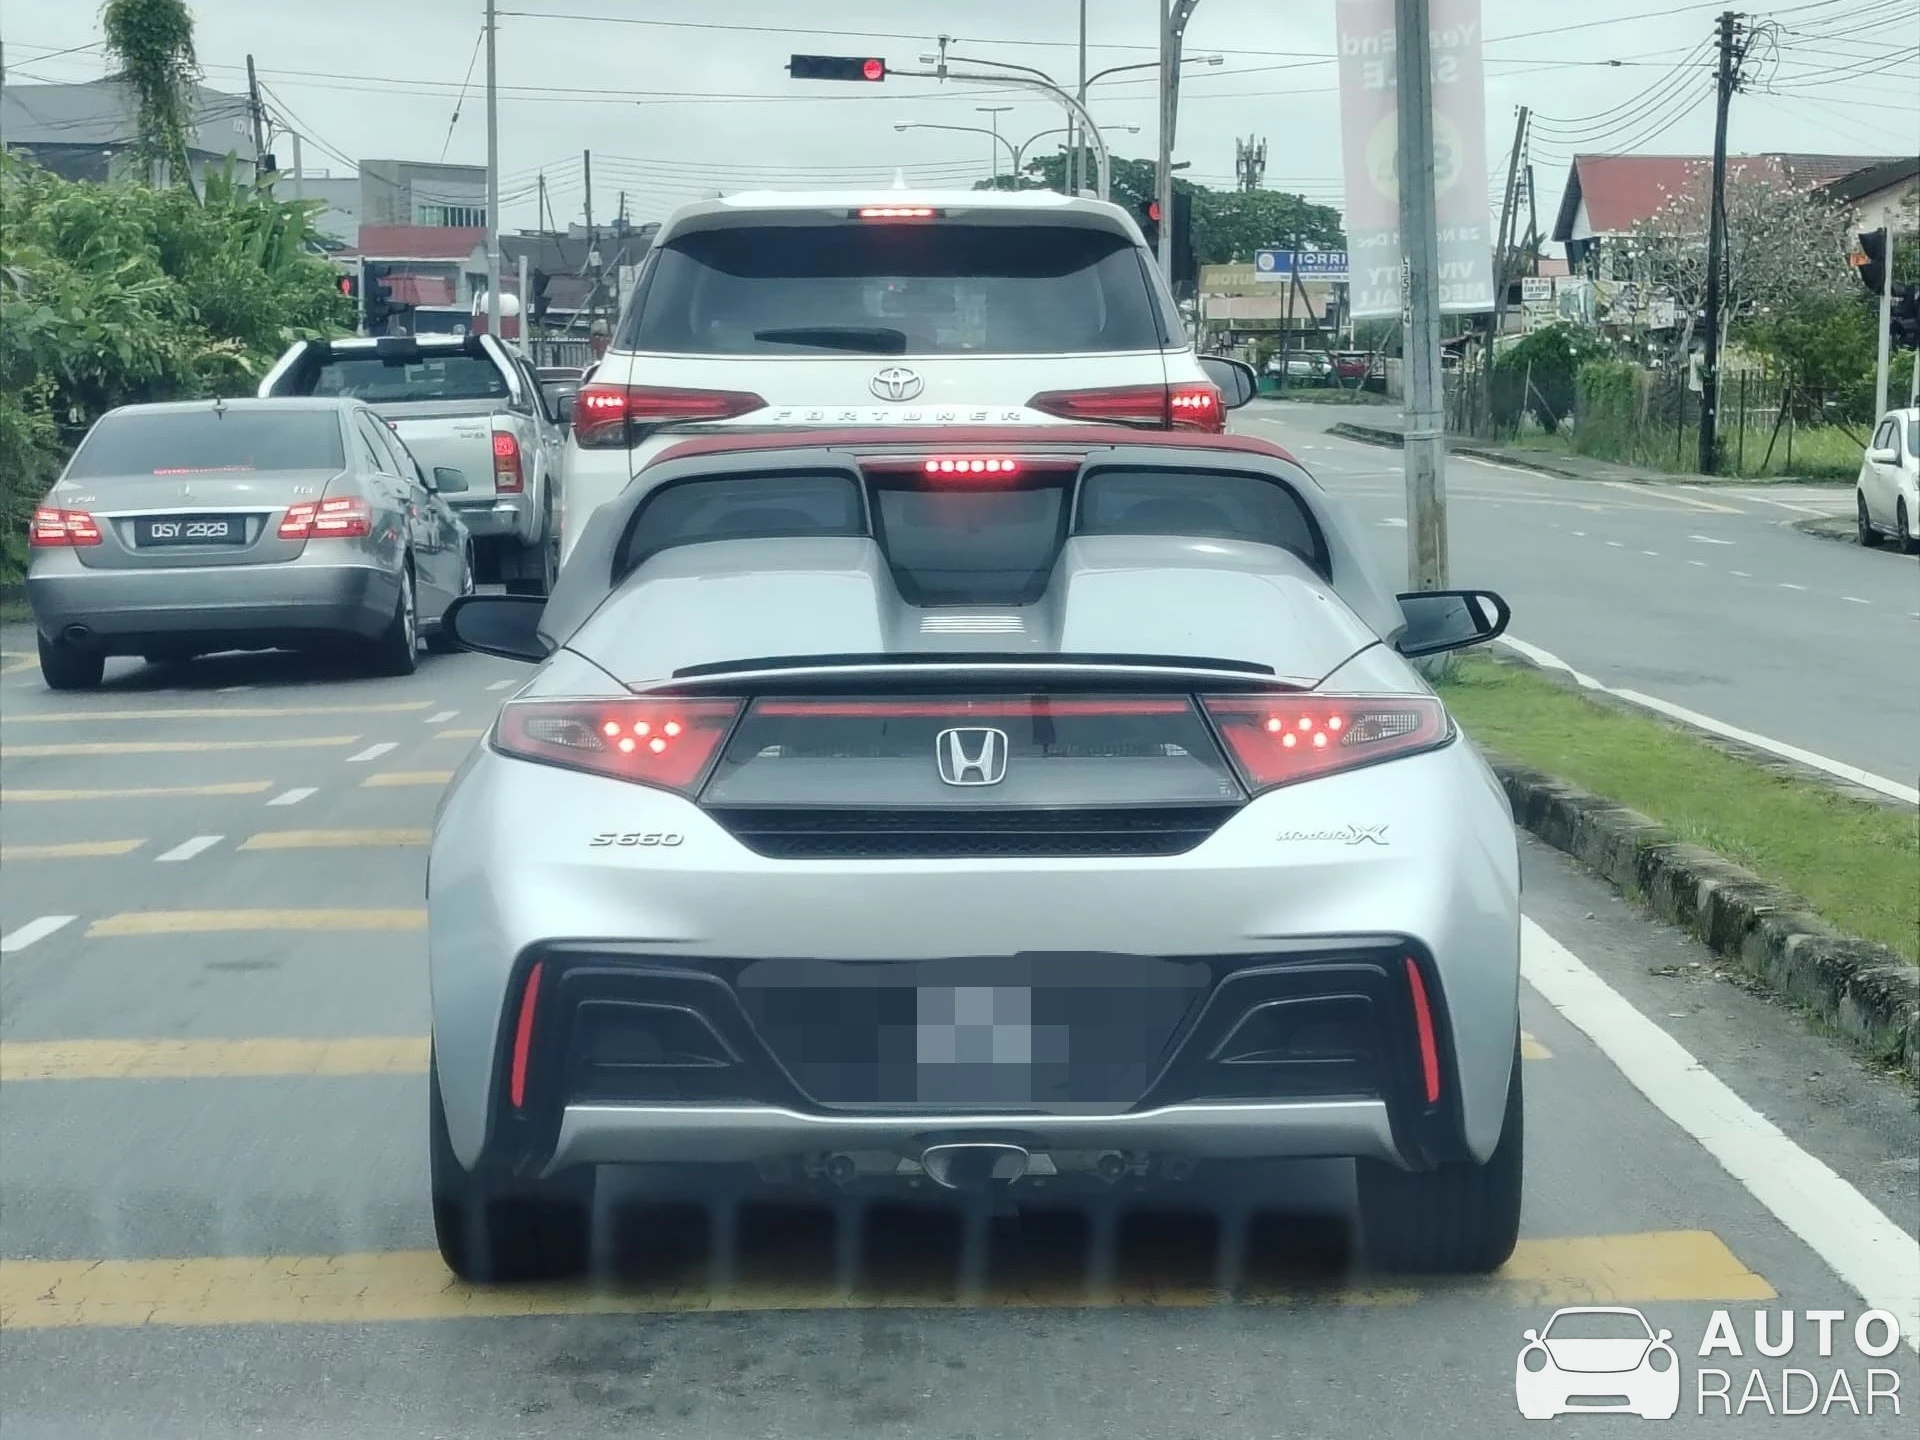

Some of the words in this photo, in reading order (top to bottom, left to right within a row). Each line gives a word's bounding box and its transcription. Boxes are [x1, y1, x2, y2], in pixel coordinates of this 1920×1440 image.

[773, 411, 1021, 421] FORTUNER
[152, 522, 181, 538] QSY
[186, 522, 228, 537] 2929
[588, 832, 684, 847] S660
